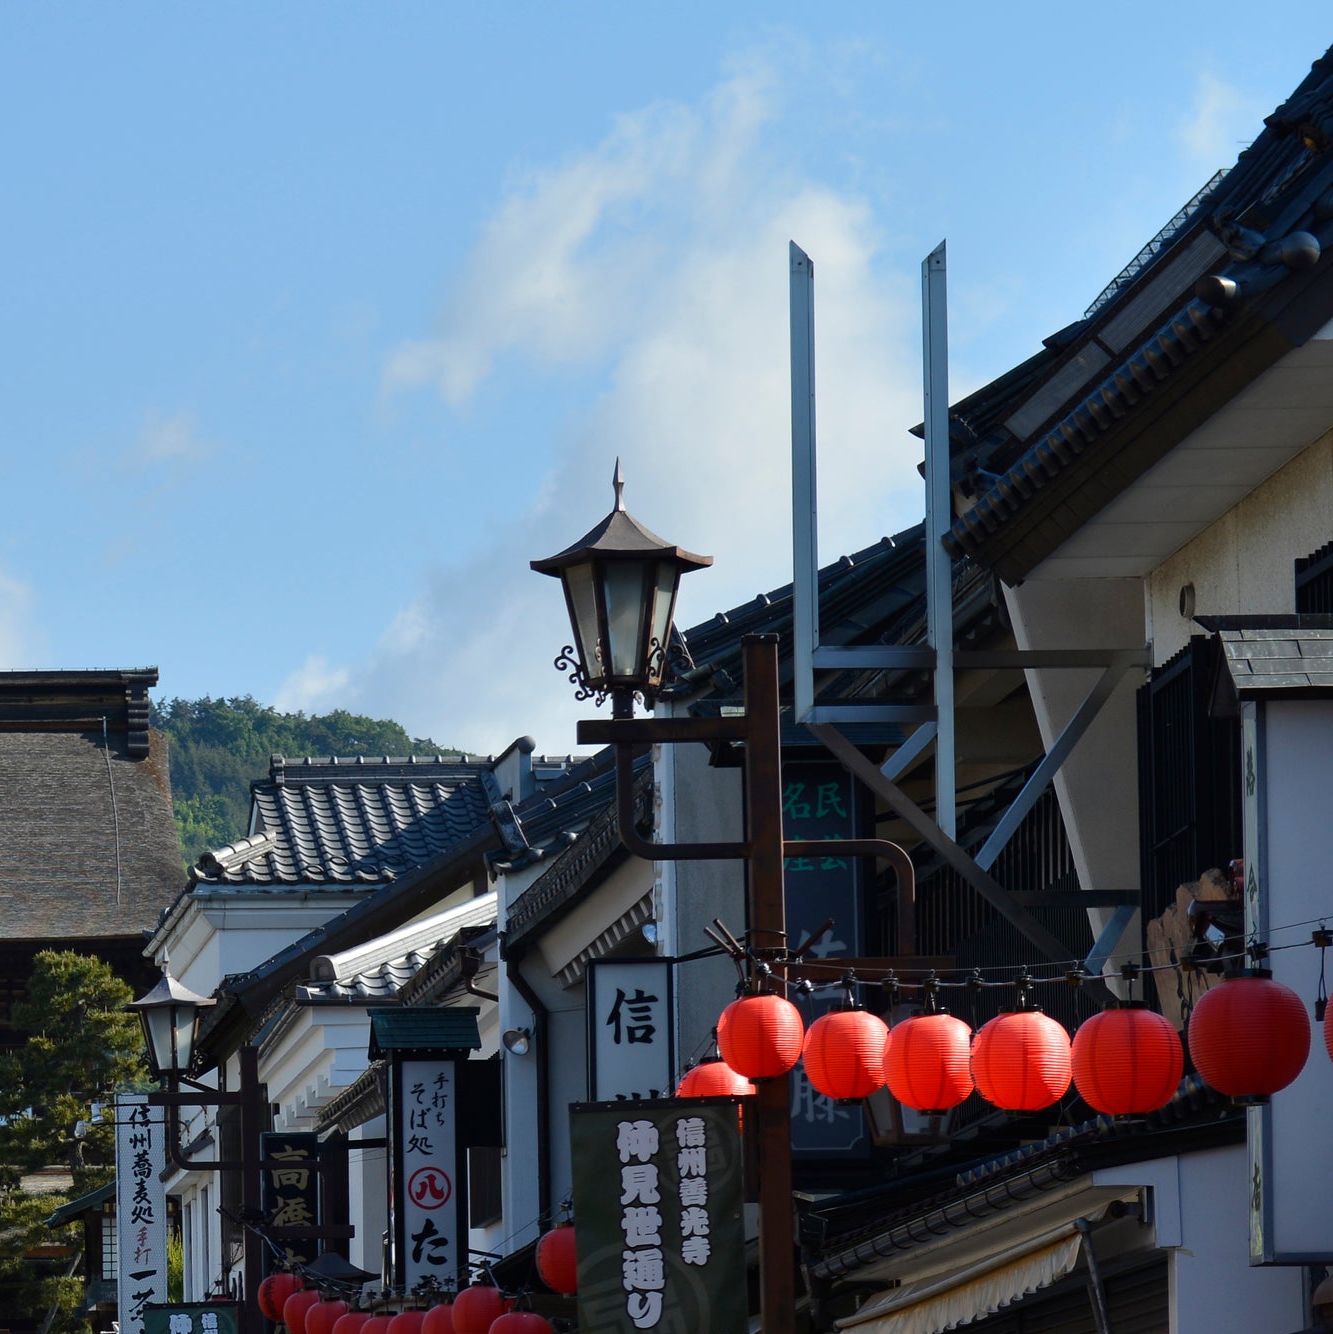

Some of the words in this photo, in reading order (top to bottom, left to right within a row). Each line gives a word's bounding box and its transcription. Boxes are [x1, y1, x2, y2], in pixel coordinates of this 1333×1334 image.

[432, 1072, 449, 1127] 手打ち
[606, 988, 661, 1100] 信
[130, 1104, 154, 1225] 信州蕎麦処
[408, 1084, 433, 1155] そば処
[615, 1118, 666, 1331] 仲見世通り
[674, 1116, 712, 1268] 信州善光寺
